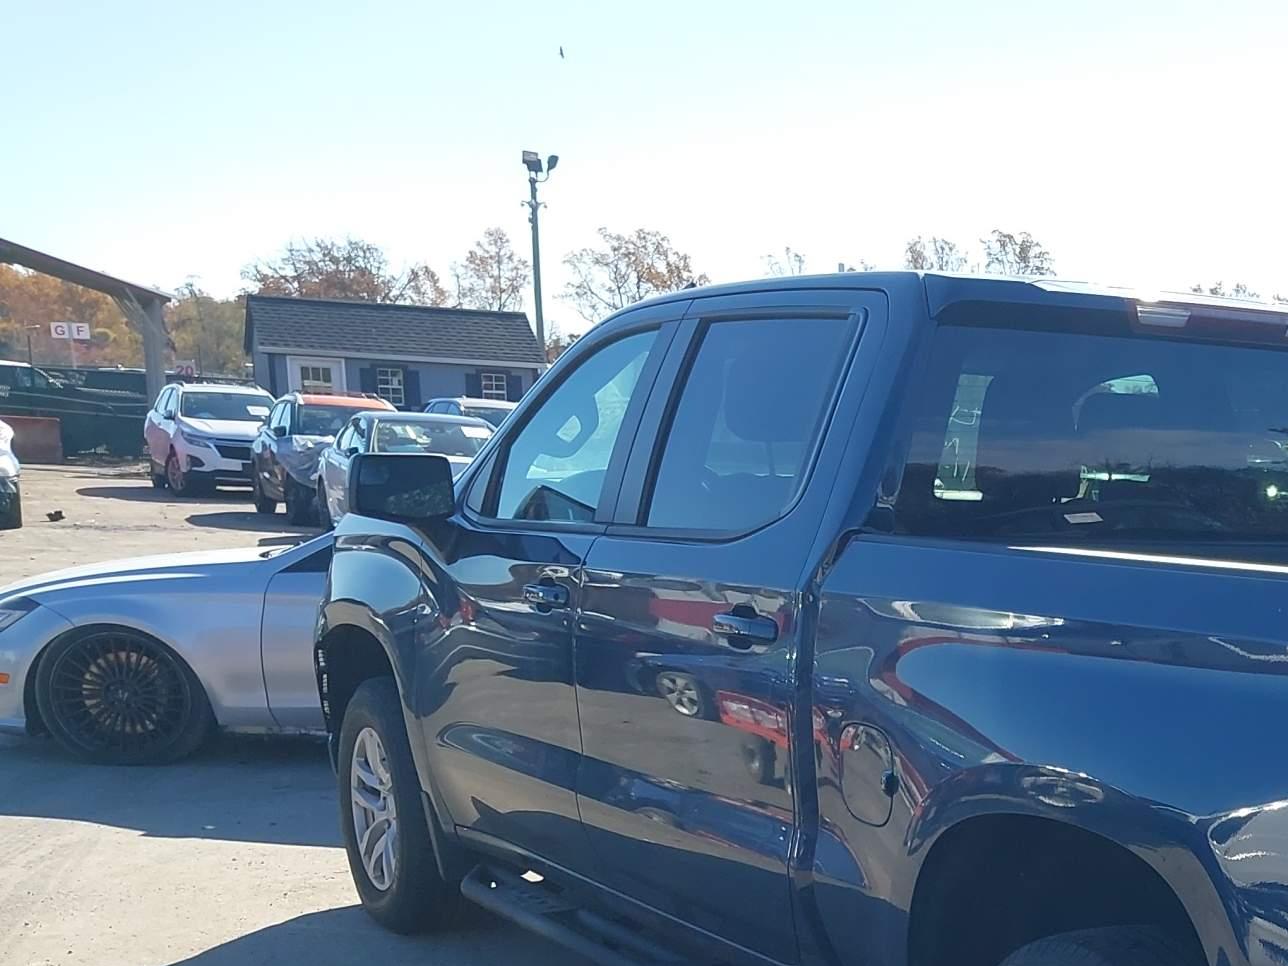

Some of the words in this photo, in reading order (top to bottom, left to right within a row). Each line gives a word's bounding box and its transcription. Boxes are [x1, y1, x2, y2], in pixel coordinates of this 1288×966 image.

[54, 325, 65, 336] G
[76, 325, 85, 336] F
[176, 365, 194, 378] 20
